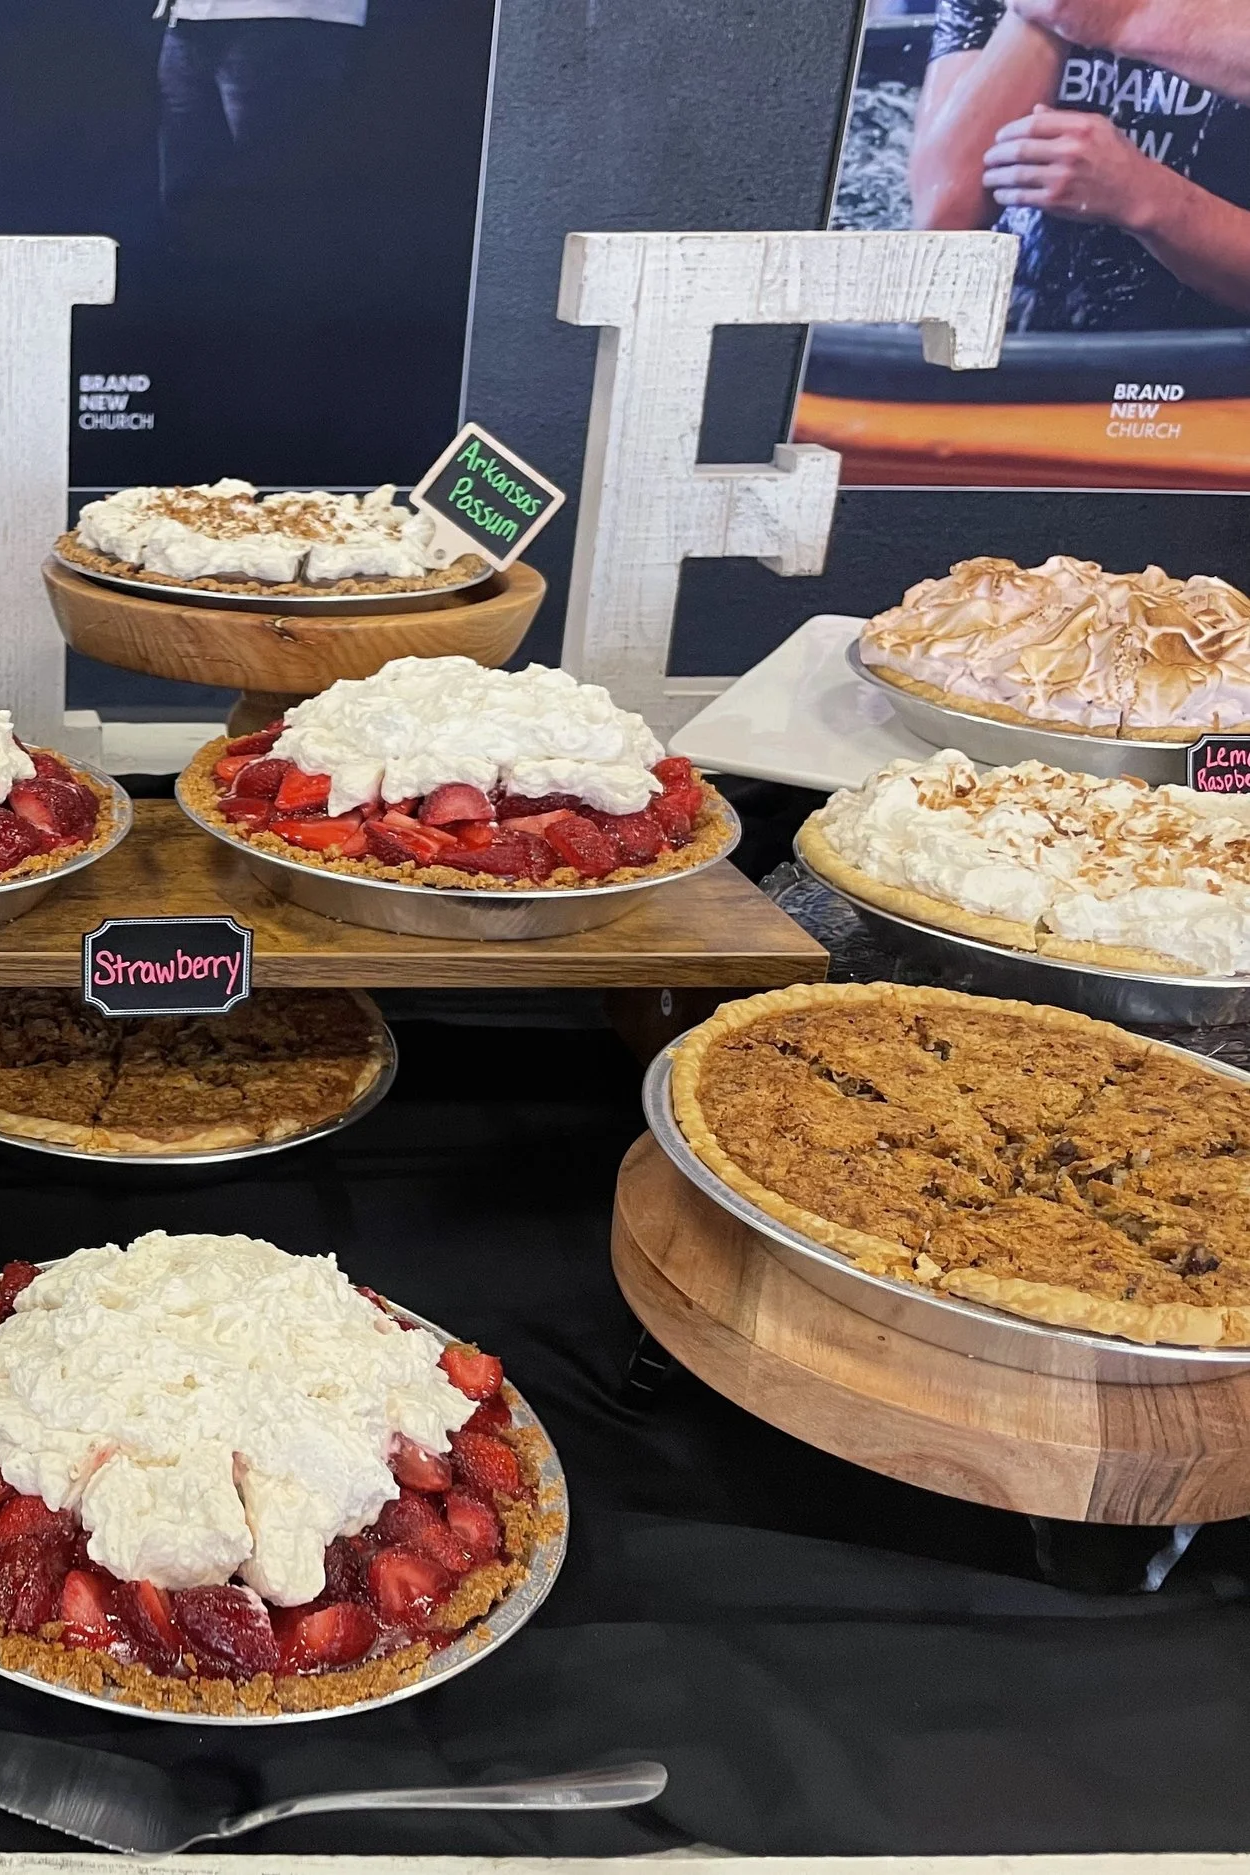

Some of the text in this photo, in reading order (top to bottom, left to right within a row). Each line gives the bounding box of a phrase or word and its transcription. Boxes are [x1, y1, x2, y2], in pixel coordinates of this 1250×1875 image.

[1058, 58, 1212, 116] BRAND
[79, 374, 151, 392] BRAND
[1113, 383, 1185, 401] BRAND
[79, 393, 130, 411] NEW
[1110, 402, 1160, 419] NEW
[78, 412, 154, 430] CHURCH
[1105, 421, 1182, 439] CHURCH
[457, 440, 542, 516] Arkansas
[448, 477, 520, 542] Possum
[94, 949, 241, 995] Strawberry
